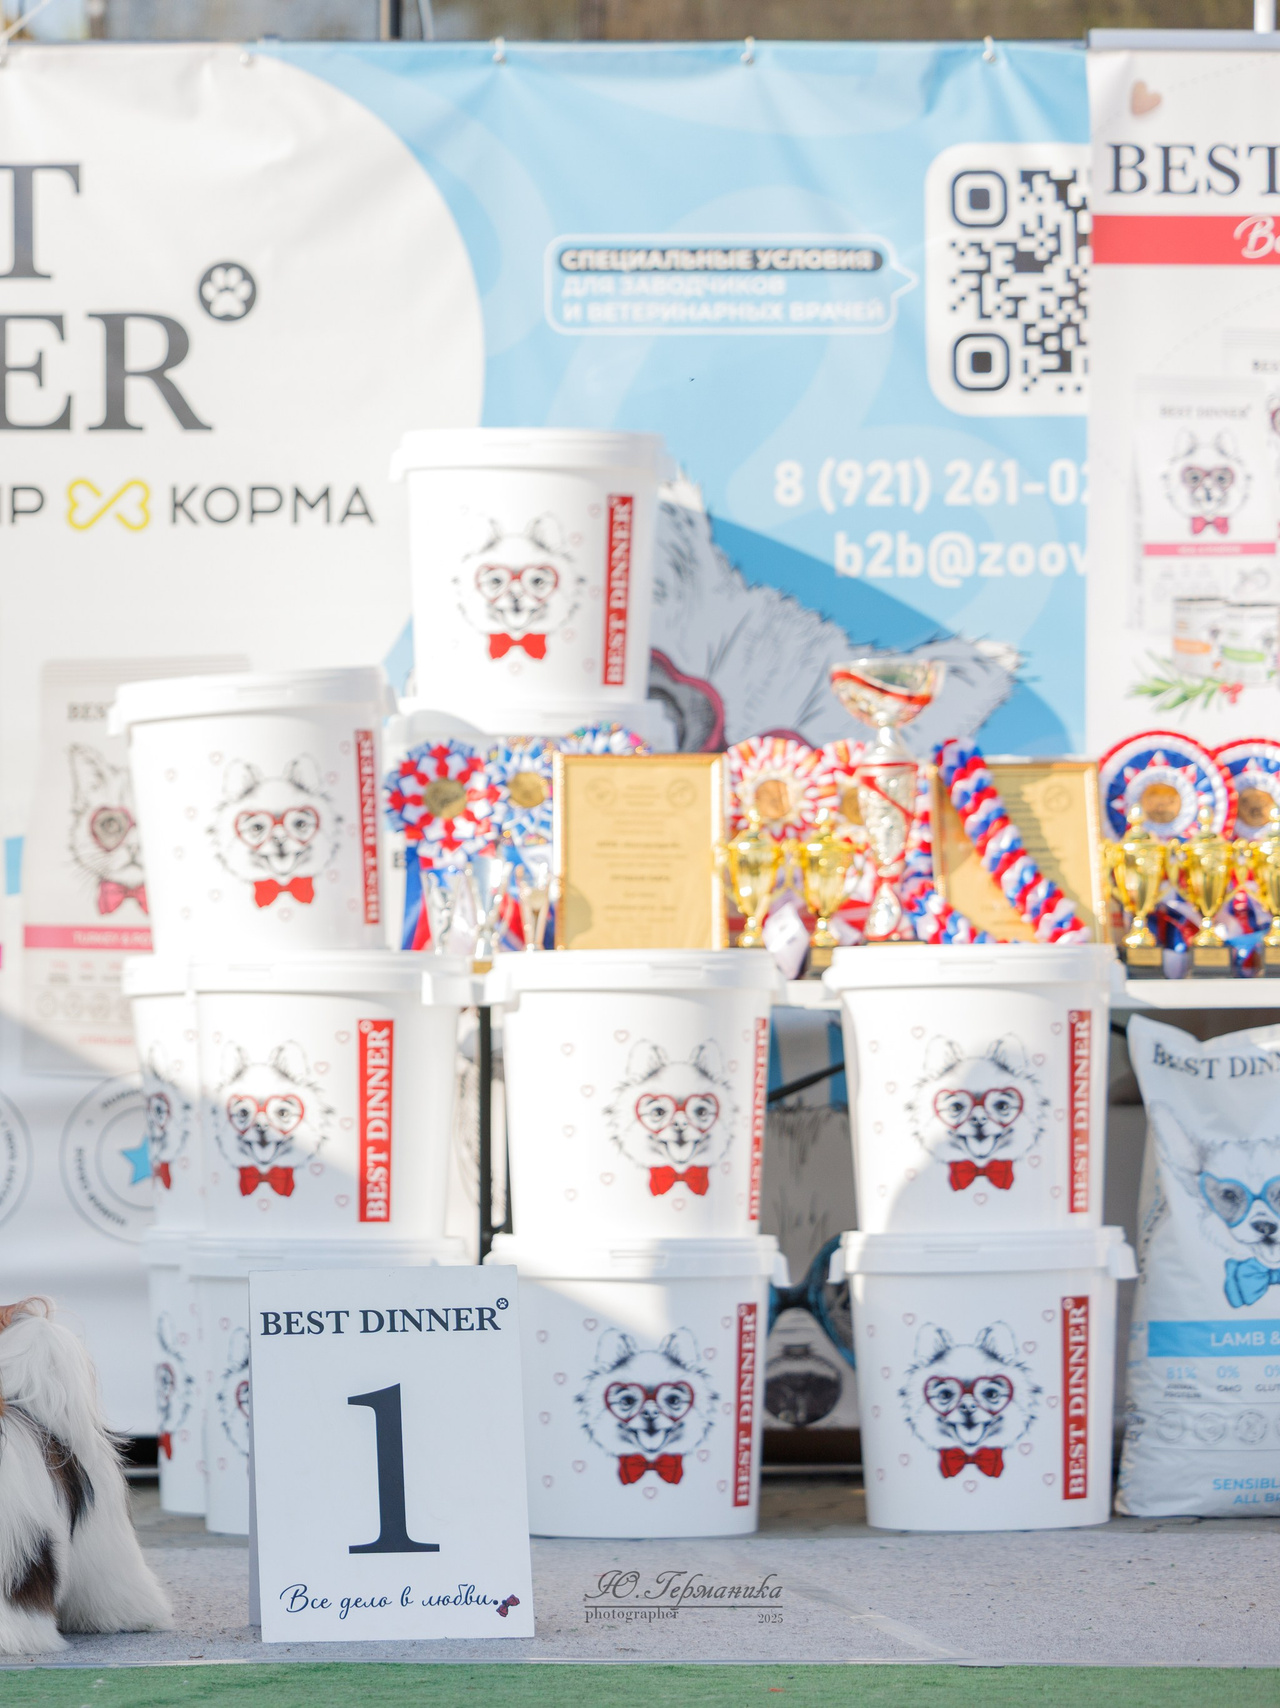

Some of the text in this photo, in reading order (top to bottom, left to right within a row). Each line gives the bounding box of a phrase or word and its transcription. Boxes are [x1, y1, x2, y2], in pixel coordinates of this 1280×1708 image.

[1106, 141, 1280, 196] BEST
[561, 248, 875, 273] СПЕЦИАЛЬНЫЕ УСЛОВИЯ
[562, 275, 786, 298] ДЛЯ ЗАВОДЧИКОВ
[563, 297, 886, 323] И ВЕТЕРИНАРНЫХ ВРАЧЕЙ
[171, 484, 375, 525] КОРМА
[774, 459, 804, 507] 8
[818, 457, 931, 514] (921)
[606, 501, 631, 683] BEST DINNER
[359, 740, 378, 921] BEST DINNER
[1153, 1043, 1220, 1079] BEST
[366, 1027, 390, 1219] BEST DINNER
[1072, 1019, 1090, 1210] BEST DINNER
[260, 1306, 502, 1336] BEST DINNER
[1210, 1331, 1266, 1347] LAMB
[735, 1312, 756, 1503] BEST DINNER
[1068, 1304, 1088, 1495] BEST DINNER
[347, 1382, 441, 1554] 1
[279, 1583, 331, 1614] Все
[339, 1592, 393, 1620] дело
[400, 1586, 414, 1606] в
